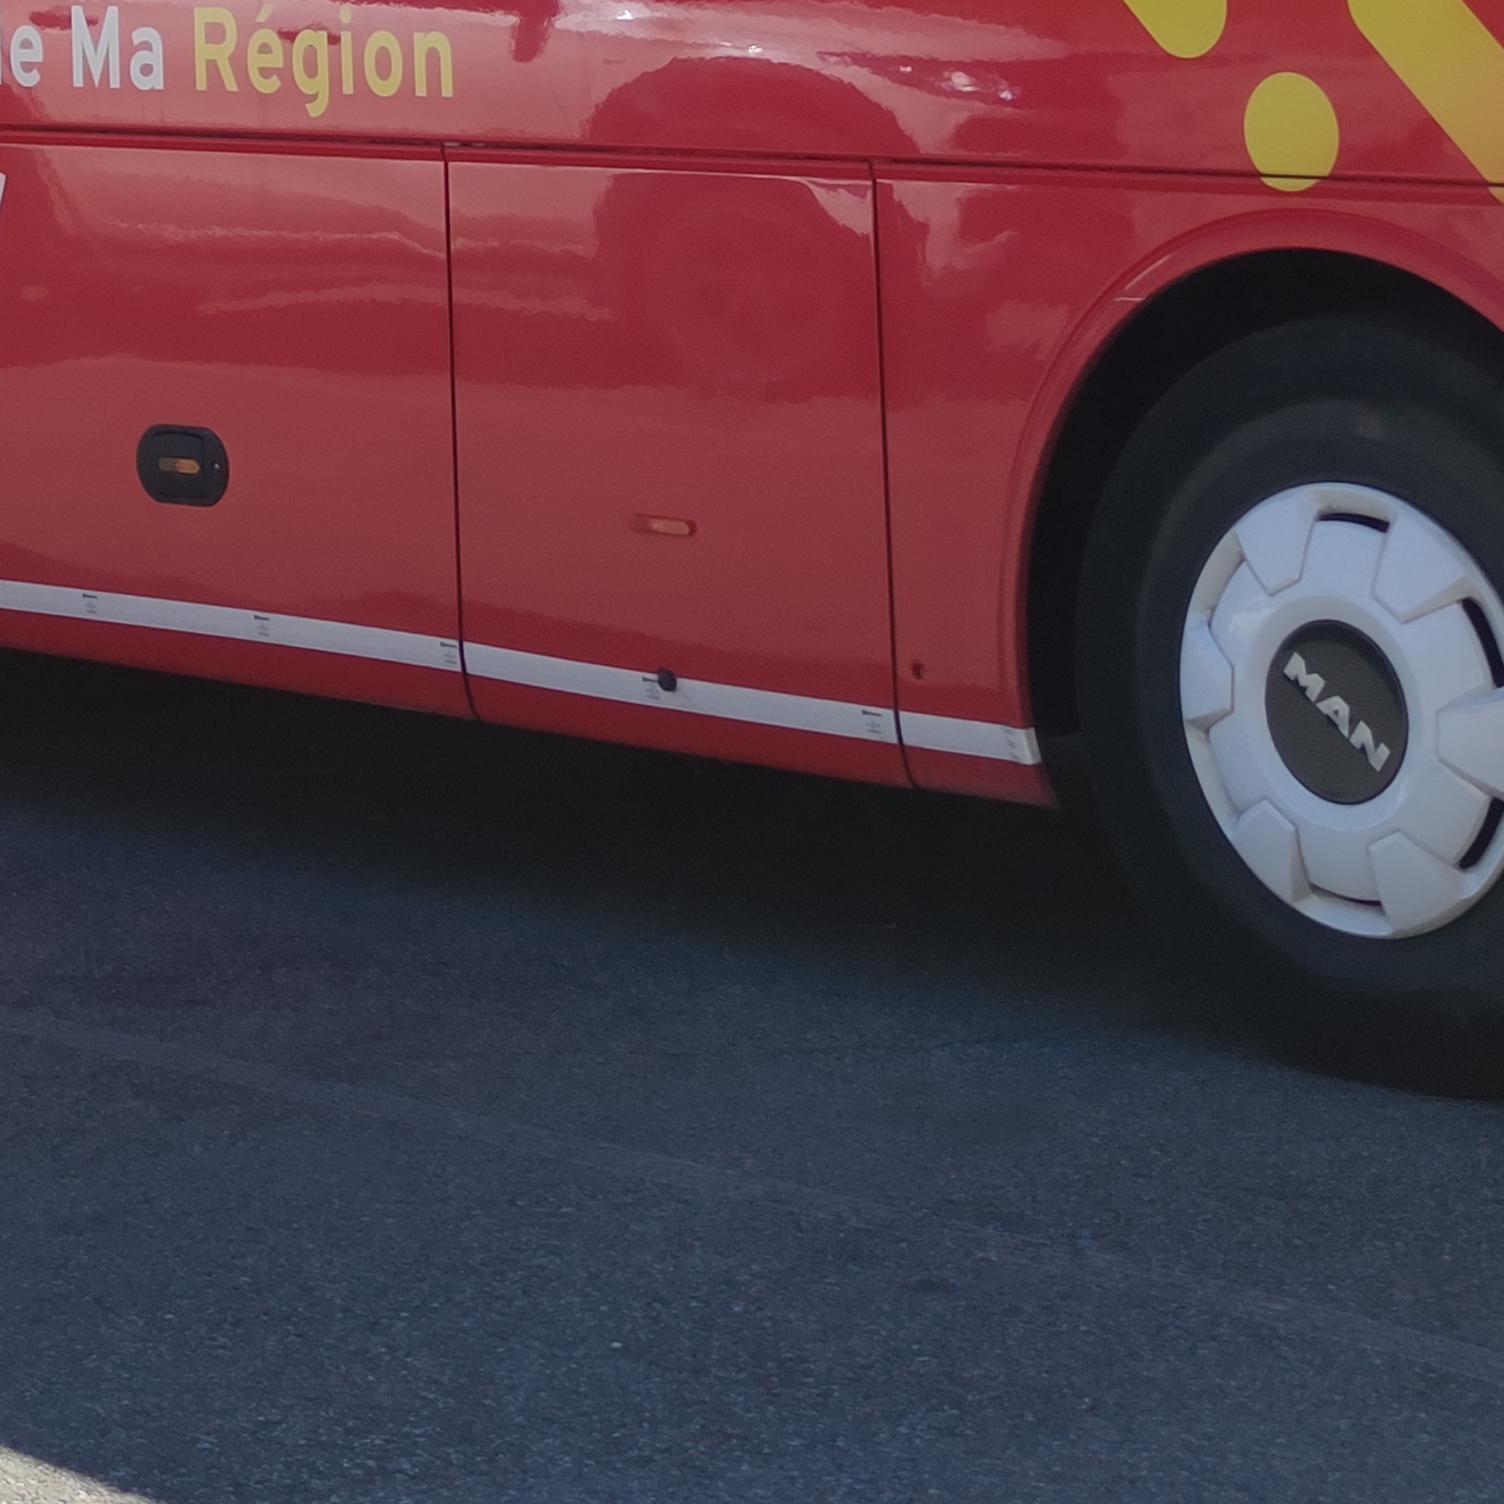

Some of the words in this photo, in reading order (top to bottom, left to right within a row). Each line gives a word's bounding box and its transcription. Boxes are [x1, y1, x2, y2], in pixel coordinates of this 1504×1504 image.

[70, 4, 165, 91] Ma
[193, 3, 454, 118] Région
[1283, 652, 1390, 771] MAN
